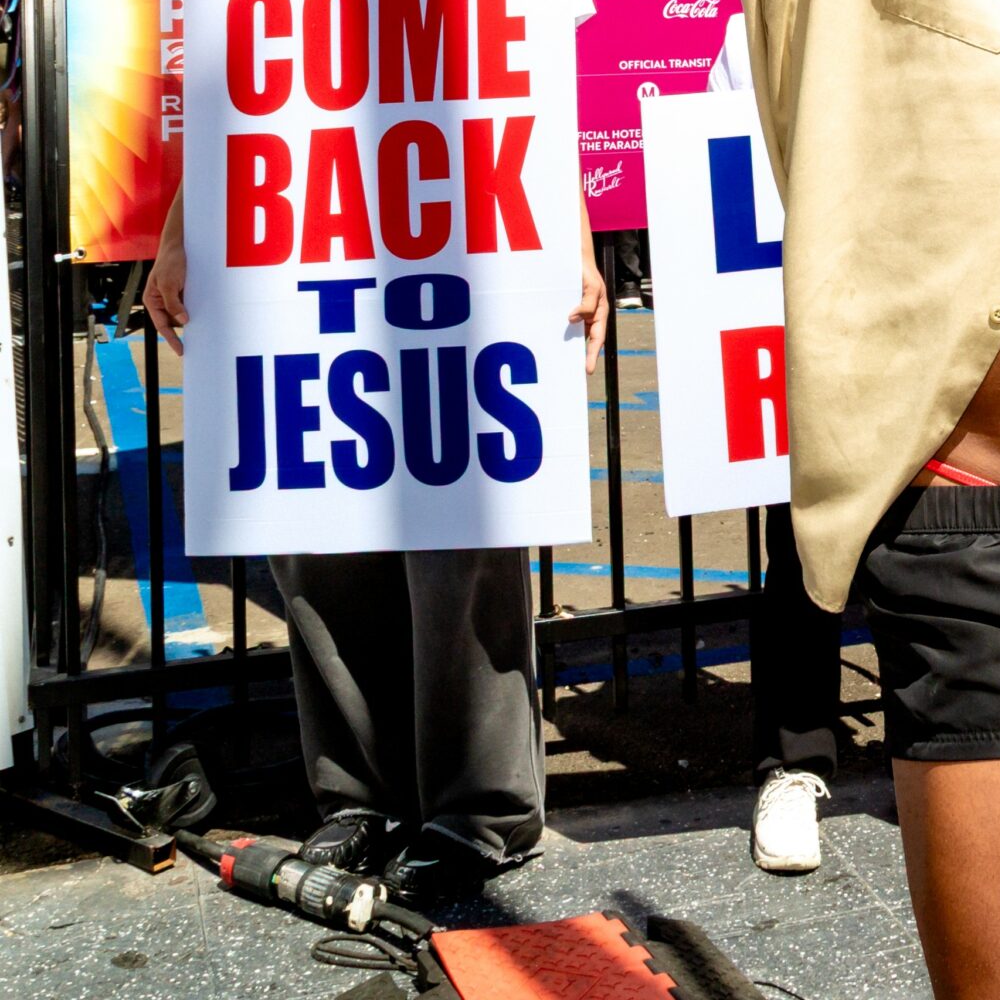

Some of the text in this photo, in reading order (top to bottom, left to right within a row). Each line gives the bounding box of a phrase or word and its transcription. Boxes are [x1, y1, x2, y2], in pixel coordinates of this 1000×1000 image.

[619, 58, 712, 71] OFFICIAL TRANSIT
[578, 129, 642, 141] FICIAL HOTE
[580, 140, 644, 151] THE PARADE
[226, 116, 543, 268] BACK
[298, 274, 471, 334] TO
[229, 342, 543, 491] JESUS
